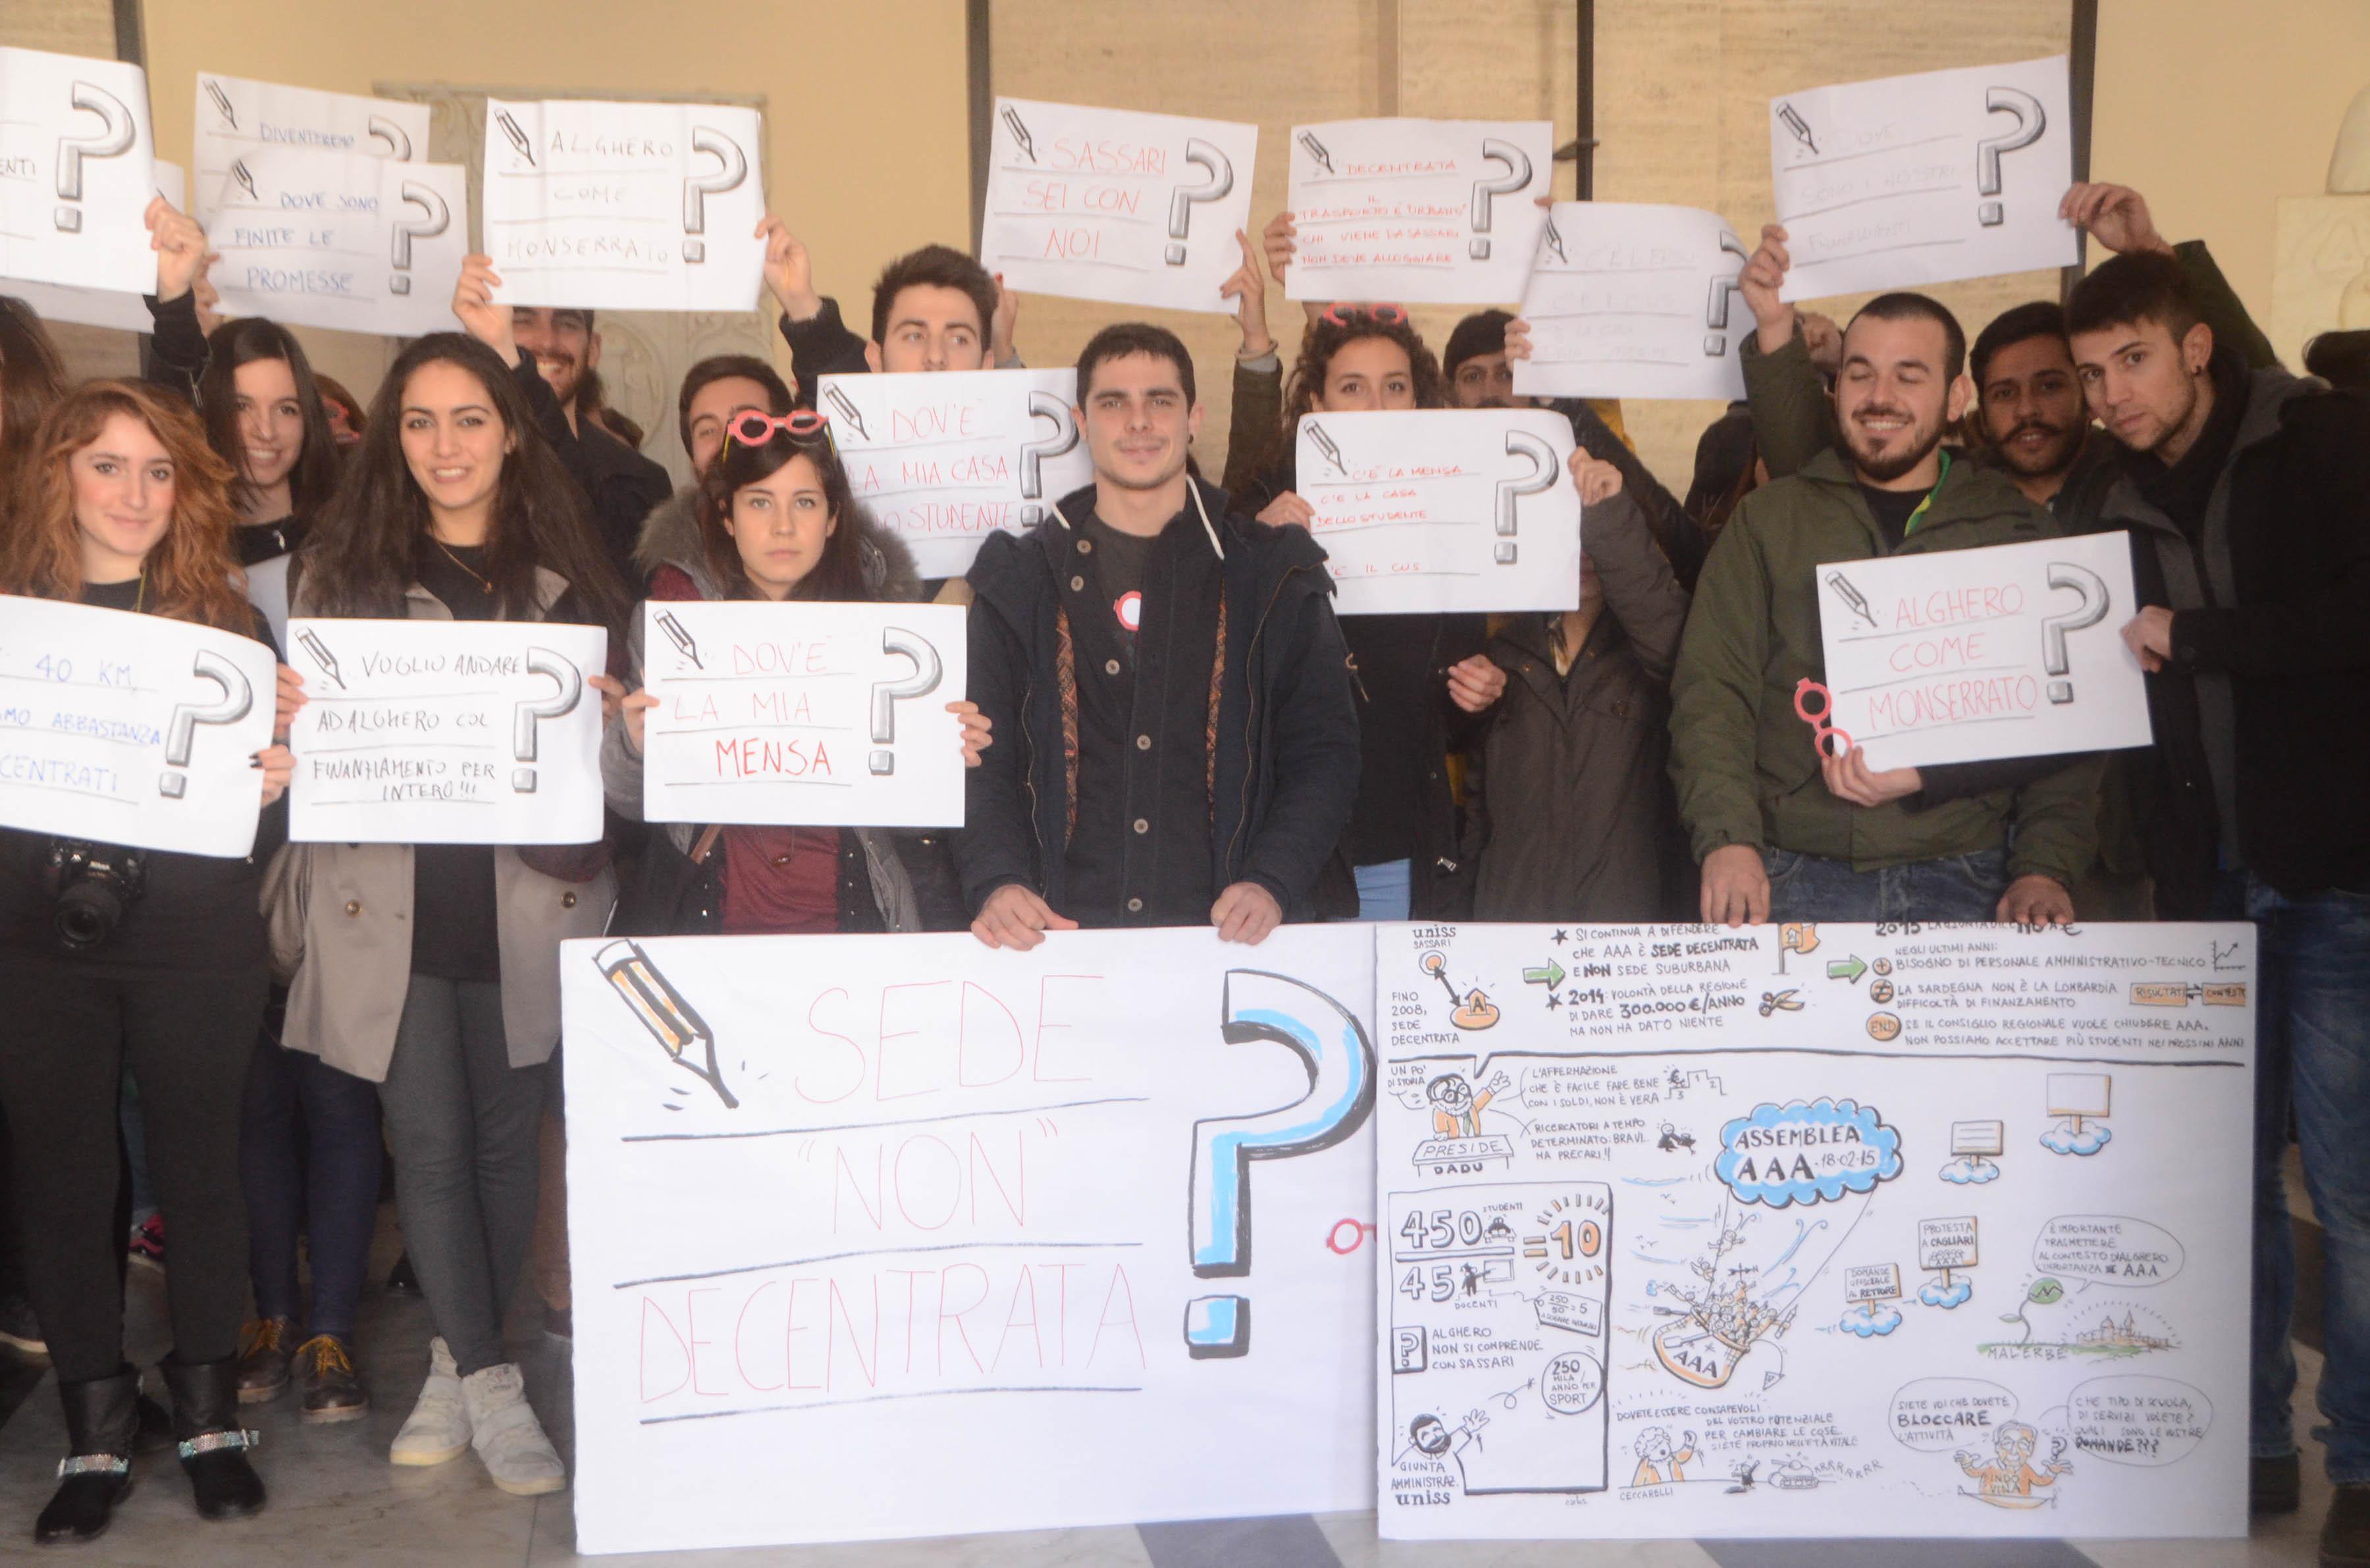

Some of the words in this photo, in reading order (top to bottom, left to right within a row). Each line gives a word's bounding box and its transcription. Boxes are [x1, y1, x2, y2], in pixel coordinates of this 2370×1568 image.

[551, 130, 673, 158] ALGHERO
[1051, 138, 1167, 174] SASSARI
[280, 194, 325, 209] DOVE
[554, 187, 629, 202] COME
[1023, 179, 1066, 212] SEI
[1084, 188, 1142, 215] CON
[234, 227, 294, 247] FINITE
[309, 230, 333, 246] LE
[1044, 227, 1100, 259] NOI
[247, 267, 354, 292] PROMESSE
[902, 460, 942, 485] MIA
[951, 454, 1009, 483] CASA
[1896, 583, 2024, 629] ALGHERO
[1889, 632, 1986, 673] COME
[36, 654, 72, 683] 40
[361, 651, 446, 679] VOGLIO
[454, 654, 520, 675] ANDARE
[674, 694, 719, 722] LA
[752, 691, 811, 723] MIA
[1868, 674, 2038, 731] MONSERRATO
[348, 708, 440, 732] ALGHERO
[456, 711, 488, 727] COL
[52, 711, 161, 745] ABBASTANZA
[715, 737, 831, 778] MENSA
[461, 761, 496, 779] PER
[1413, 925, 1456, 938] uniss
[1591, 928, 1641, 939] CONTINUA
[1413, 939, 1451, 949] SASSARI
[1603, 944, 1632, 958] AAA
[1638, 943, 1646, 958] È
[1650, 942, 1681, 958] SEDE
[1685, 937, 1759, 956] DECENTRATA
[1895, 946, 1926, 956] NEGLI
[1929, 944, 1964, 954] ULTIMI
[1583, 963, 1611, 978] NON
[1617, 962, 1649, 976] SEDE
[1656, 959, 1731, 975] SUBURBANA
[1895, 958, 1952, 970] BISOGNO
[1975, 957, 2038, 968] PERSONALE
[1612, 983, 1657, 1001] VOLONTÀ
[1661, 983, 1693, 995] DELLA
[1698, 979, 1748, 993] REGIONE
[1897, 985, 1912, 995] LA
[1918, 983, 1984, 993] SARDEGNA
[1992, 982, 2015, 993] NON
[2034, 982, 2049, 993] LA
[2055, 980, 2118, 994] LOMBARDIA
[1392, 991, 1419, 1001] FINO
[1897, 995, 1959, 1008] DIFFICOLTÀ
[1582, 1009, 1613, 1021] DARE
[1620, 1001, 1685, 1020] 300.000
[1392, 1020, 1421, 1031] SEDE
[1569, 1026, 1585, 1037] MA
[1590, 1025, 1612, 1035] NON
[1617, 1022, 1633, 1033] HA
[1639, 1019, 1672, 1032] DATO
[1679, 1016, 1724, 1028] NIENTE
[1870, 1020, 1897, 1034] END
[1905, 1019, 1920, 1031] SE
[1938, 1019, 1997, 1030] CONSIGLIO
[2002, 1018, 2065, 1030] REGIONALE
[2072, 1018, 2107, 1029] VUOLE
[2114, 1018, 2171, 1030] CHIUDERE
[795, 975, 1104, 1103] SEDE
[1391, 1033, 1460, 1046] DECENTRATA
[1905, 1035, 1928, 1046] NON
[1934, 1035, 1990, 1047] POSSIAMO
[1995, 1035, 2059, 1048] ACCETTARE
[2066, 1033, 2084, 1047] PIÙ
[2089, 1036, 2142, 1047] STUDENTI
[2217, 1037, 2244, 1049] ANNI
[1390, 1066, 1406, 1076] UN
[1533, 1065, 1618, 1079] L'AFFERMAZIONE
[1397, 1077, 1425, 1086] STORIA
[1529, 1084, 1547, 1093] CHE
[1567, 1082, 1600, 1092] FACILE
[1607, 1080, 1631, 1091] FARE
[1633, 1077, 1660, 1089] BENE
[1528, 1098, 1548, 1107] CON
[1594, 1095, 1614, 1106] NON
[1630, 1092, 1660, 1106] VERA
[1535, 1120, 1598, 1133] RICERCATORI
[1612, 1118, 1645, 1130] TEMPO
[1735, 1125, 1861, 1149] ASSEMBLEA
[1423, 1141, 1504, 1157] PRESIDE
[1536, 1150, 1551, 1160] MA
[1434, 1163, 1483, 1175] DADU
[1737, 1153, 1816, 1182] AAA
[1482, 1202, 1523, 1213] STUDENTI
[1401, 1209, 1482, 1249] 450
[1924, 1222, 1973, 1234] PROTESTA
[2059, 1223, 2122, 1234] IMPORTANTE
[1930, 1235, 1974, 1247] CAGLIARI
[2052, 1250, 2108, 1261] CONTESTO
[1400, 1265, 1456, 1303] 45
[1454, 1299, 1498, 1310] DOCENTI
[640, 1263, 1146, 1403] DECENTRATA
[1432, 1327, 1492, 1339] ALGHERO
[1432, 1343, 1458, 1355] NON
[1477, 1340, 1544, 1351] COMPRENDE
[1988, 1347, 2069, 1361] MALERBE
[1432, 1360, 1456, 1370] CON
[1459, 1356, 1514, 1370] SASSARI
[1552, 1359, 1581, 1375] 250
[1673, 1351, 1718, 1378] AAA
[1551, 1382, 1579, 1392] ANNO
[1548, 1392, 1587, 1405] SPORT
[1897, 1400, 1928, 1410] SIETE
[1949, 1397, 1968, 1407] CHE
[1617, 1409, 1653, 1422] DOVETE
[1695, 1403, 1760, 1415] CONSAPEVOLI
[1897, 1410, 1991, 1427] BLOCCARE
[1727, 1415, 1765, 1426] VOSTRO
[1705, 1430, 1726, 1440] PER
[1733, 1428, 1787, 1439] CAMBIARE
[1400, 1462, 1446, 1473] GIUNTA
[1395, 1490, 1451, 1506] uniss
[1619, 1488, 1673, 1501] CECCARELLI
